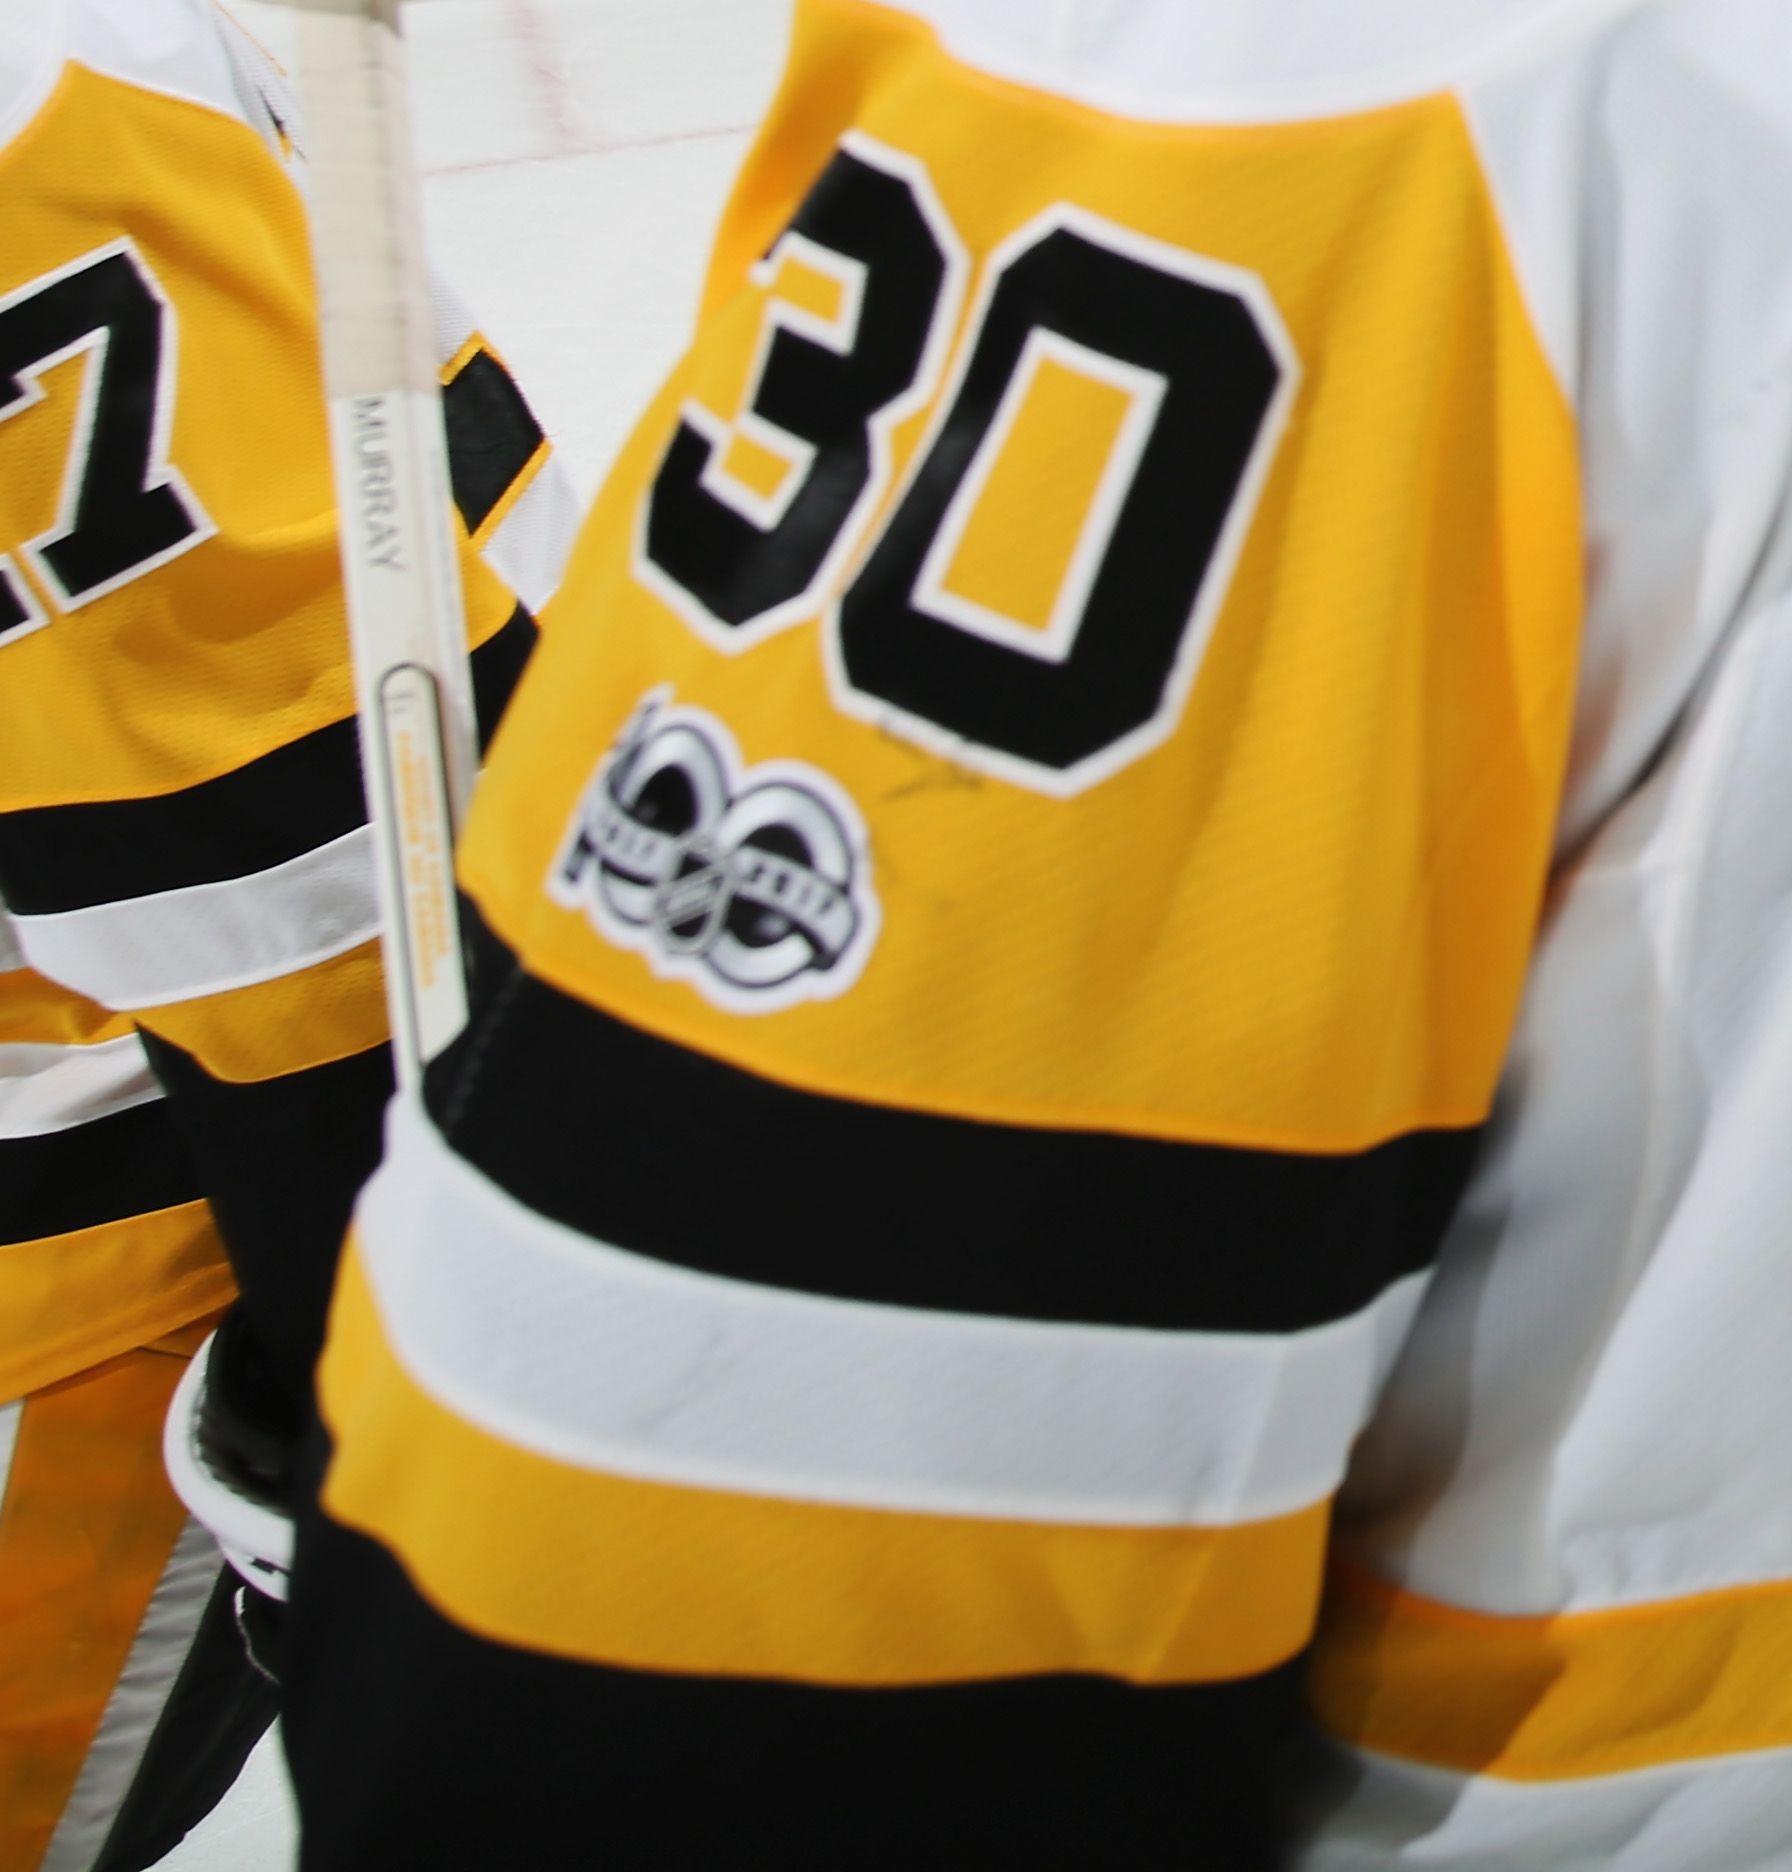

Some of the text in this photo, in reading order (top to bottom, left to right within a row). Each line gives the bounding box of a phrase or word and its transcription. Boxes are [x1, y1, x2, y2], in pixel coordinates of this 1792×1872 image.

[0, 234, 216, 644] 7
[347, 394, 407, 576] MURRAY
[632, 128, 1303, 800] 30
